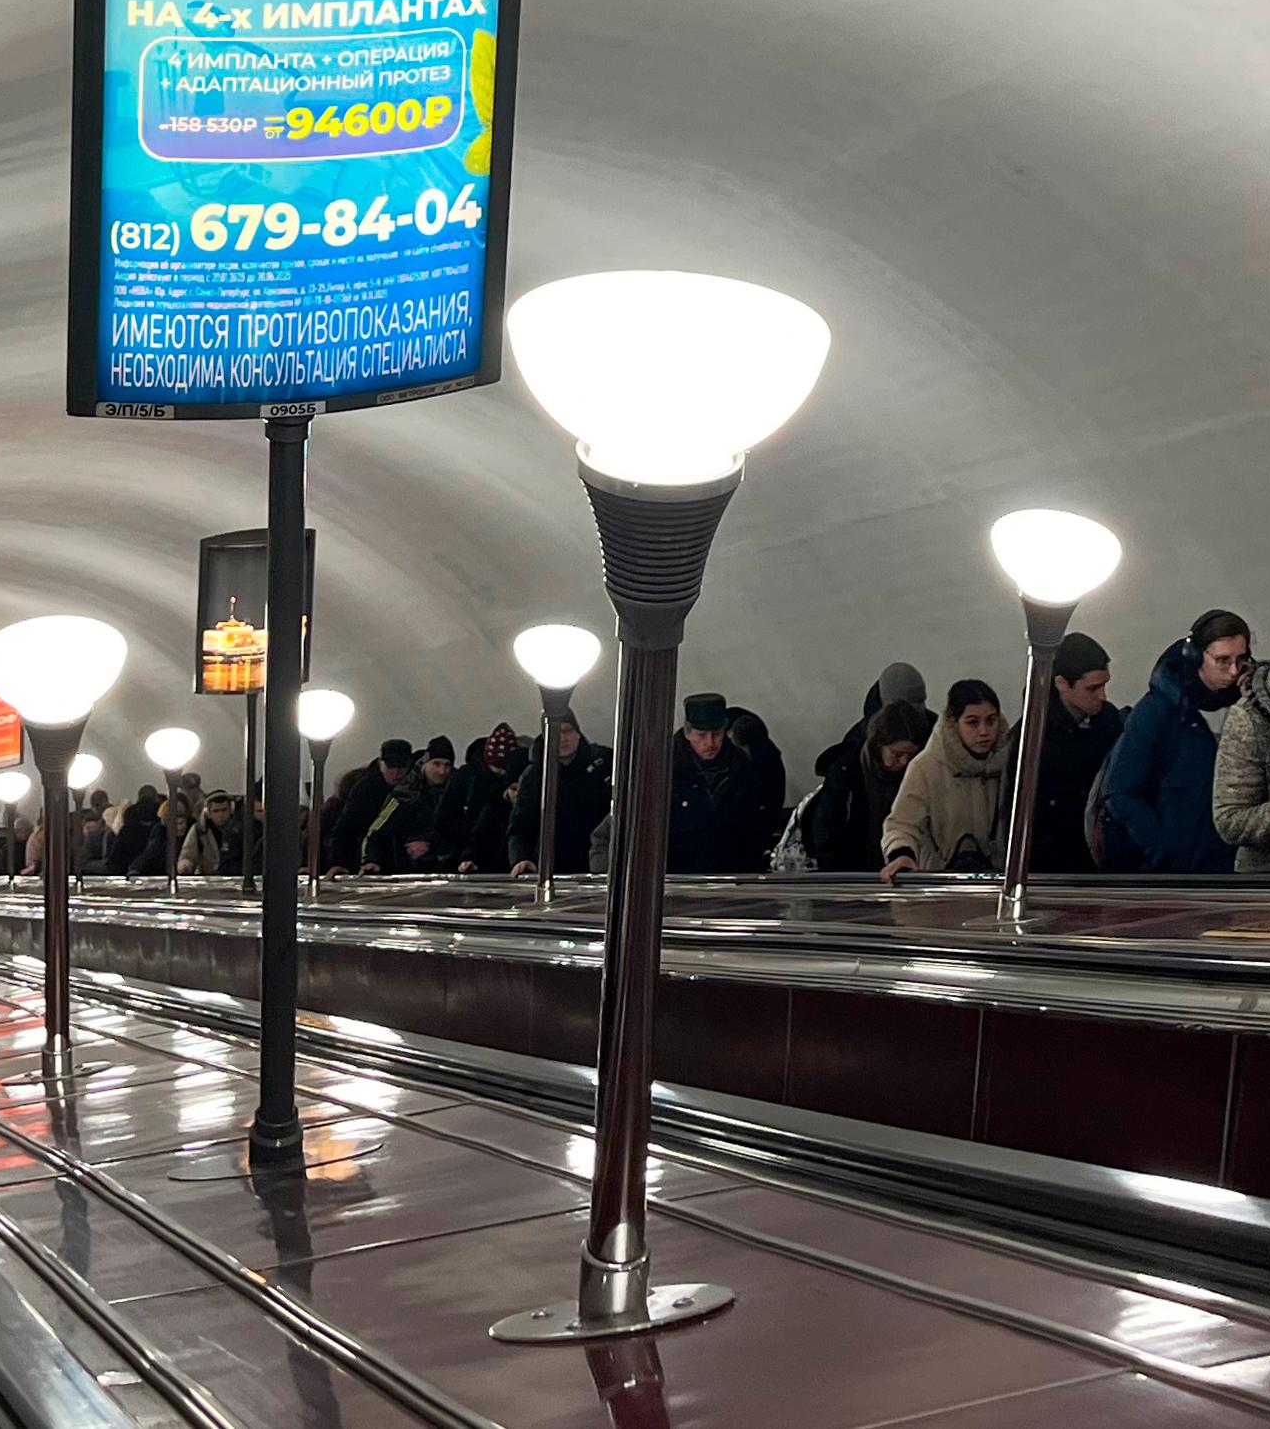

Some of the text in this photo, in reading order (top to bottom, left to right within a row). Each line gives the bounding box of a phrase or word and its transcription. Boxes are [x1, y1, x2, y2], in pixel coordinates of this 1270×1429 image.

[127, 0, 184, 28] НА
[193, 0, 252, 29] 4-х
[168, 52, 183, 67] 4
[187, 52, 316, 70] ИМПЛАНТА
[337, 41, 450, 67] ОПЕРАЦИЯ
[176, 69, 373, 94] АДАПТАЦИОННЫЙ
[379, 65, 451, 87] ПРОТЕЗ
[111, 184, 482, 255] (812) 679-84-04
[112, 289, 473, 349] ИМЕЮТСЯ ПРОТИВОПОКАЗАНИЯ,
[111, 351, 226, 393] НЕОБХОДИМА
[230, 345, 357, 391] КОНСУЛЬТАЦИЯ
[361, 329, 467, 379] СПЕЦИАЛИСТА
[105, 403, 166, 418] Э/П/5/Б
